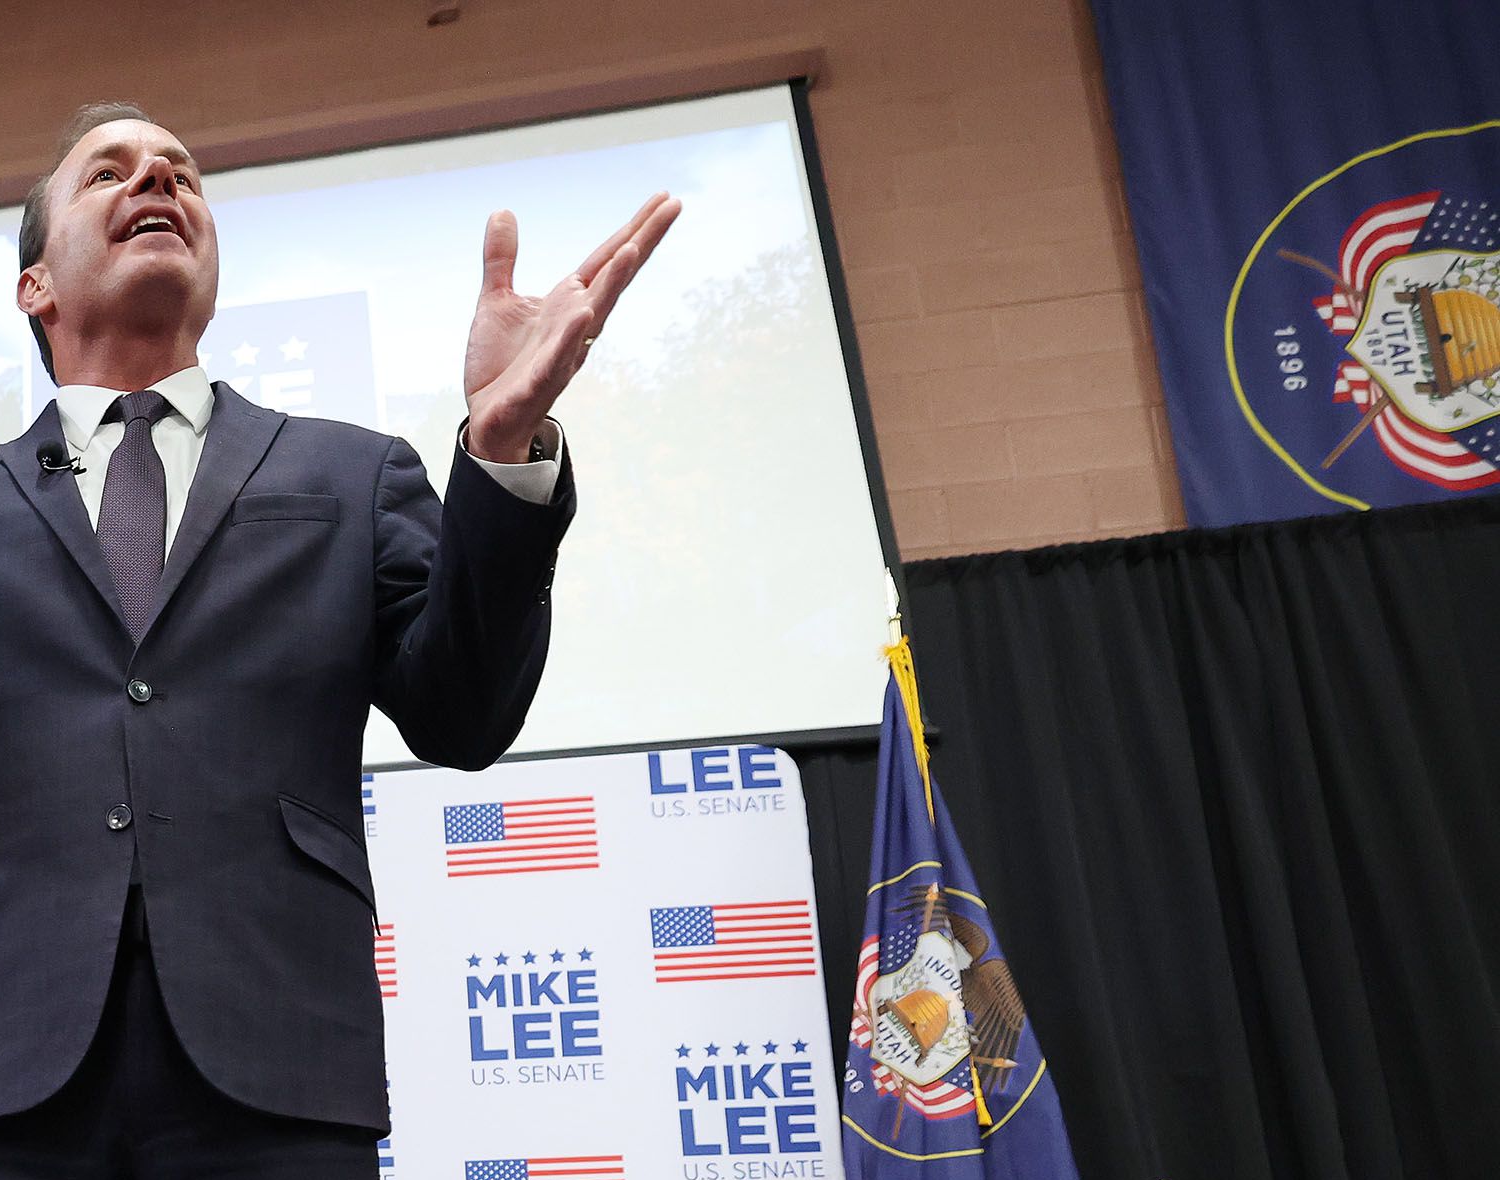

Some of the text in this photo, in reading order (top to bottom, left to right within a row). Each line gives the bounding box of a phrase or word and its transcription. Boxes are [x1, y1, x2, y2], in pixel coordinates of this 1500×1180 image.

[1274, 325, 1308, 391] 1896
[1381, 311, 1416, 376] UTAH
[648, 748, 781, 794] LEE
[652, 794, 786, 818] U.S. SENATE
[466, 969, 599, 1009] MIKE
[469, 1010, 602, 1062] LEE
[876, 1022, 911, 1064] UTAH
[472, 1063, 605, 1086] U.S. SENATE
[675, 1061, 815, 1102] MIKE
[679, 1104, 822, 1157] LEE
[733, 1158, 825, 1180] SENATE
